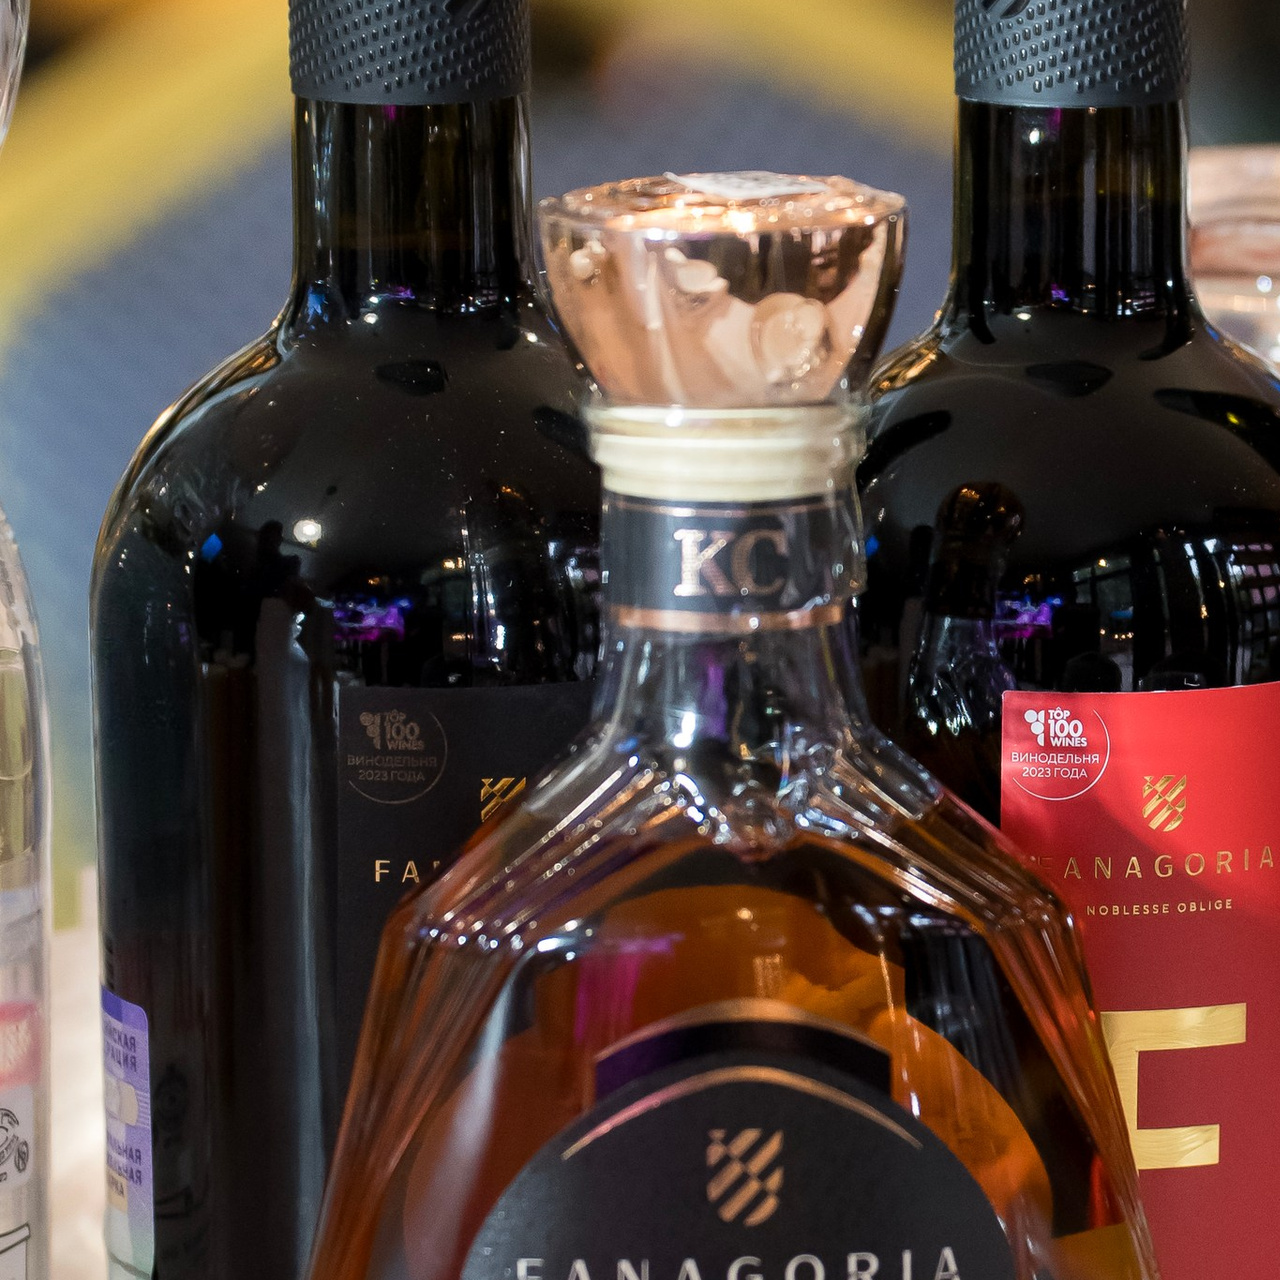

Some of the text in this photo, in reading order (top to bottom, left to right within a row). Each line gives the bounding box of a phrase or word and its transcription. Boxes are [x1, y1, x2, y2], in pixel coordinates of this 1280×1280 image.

[384, 721, 421, 740] 100
[1048, 719, 1083, 737] 100
[386, 740, 425, 751] WINES
[1050, 737, 1088, 747] WINES
[347, 755, 438, 768] ВИНОДЕЛЬНЯ
[1011, 752, 1100, 765] ВИНОДЕЛЬНЯ
[358, 770, 426, 783] 2023 ГОДА
[1022, 767, 1088, 779] 2023 ГОДА
[1086, 898, 1233, 917] NOBLESSE OBLIGE
[1101, 1002, 1247, 1176] F
